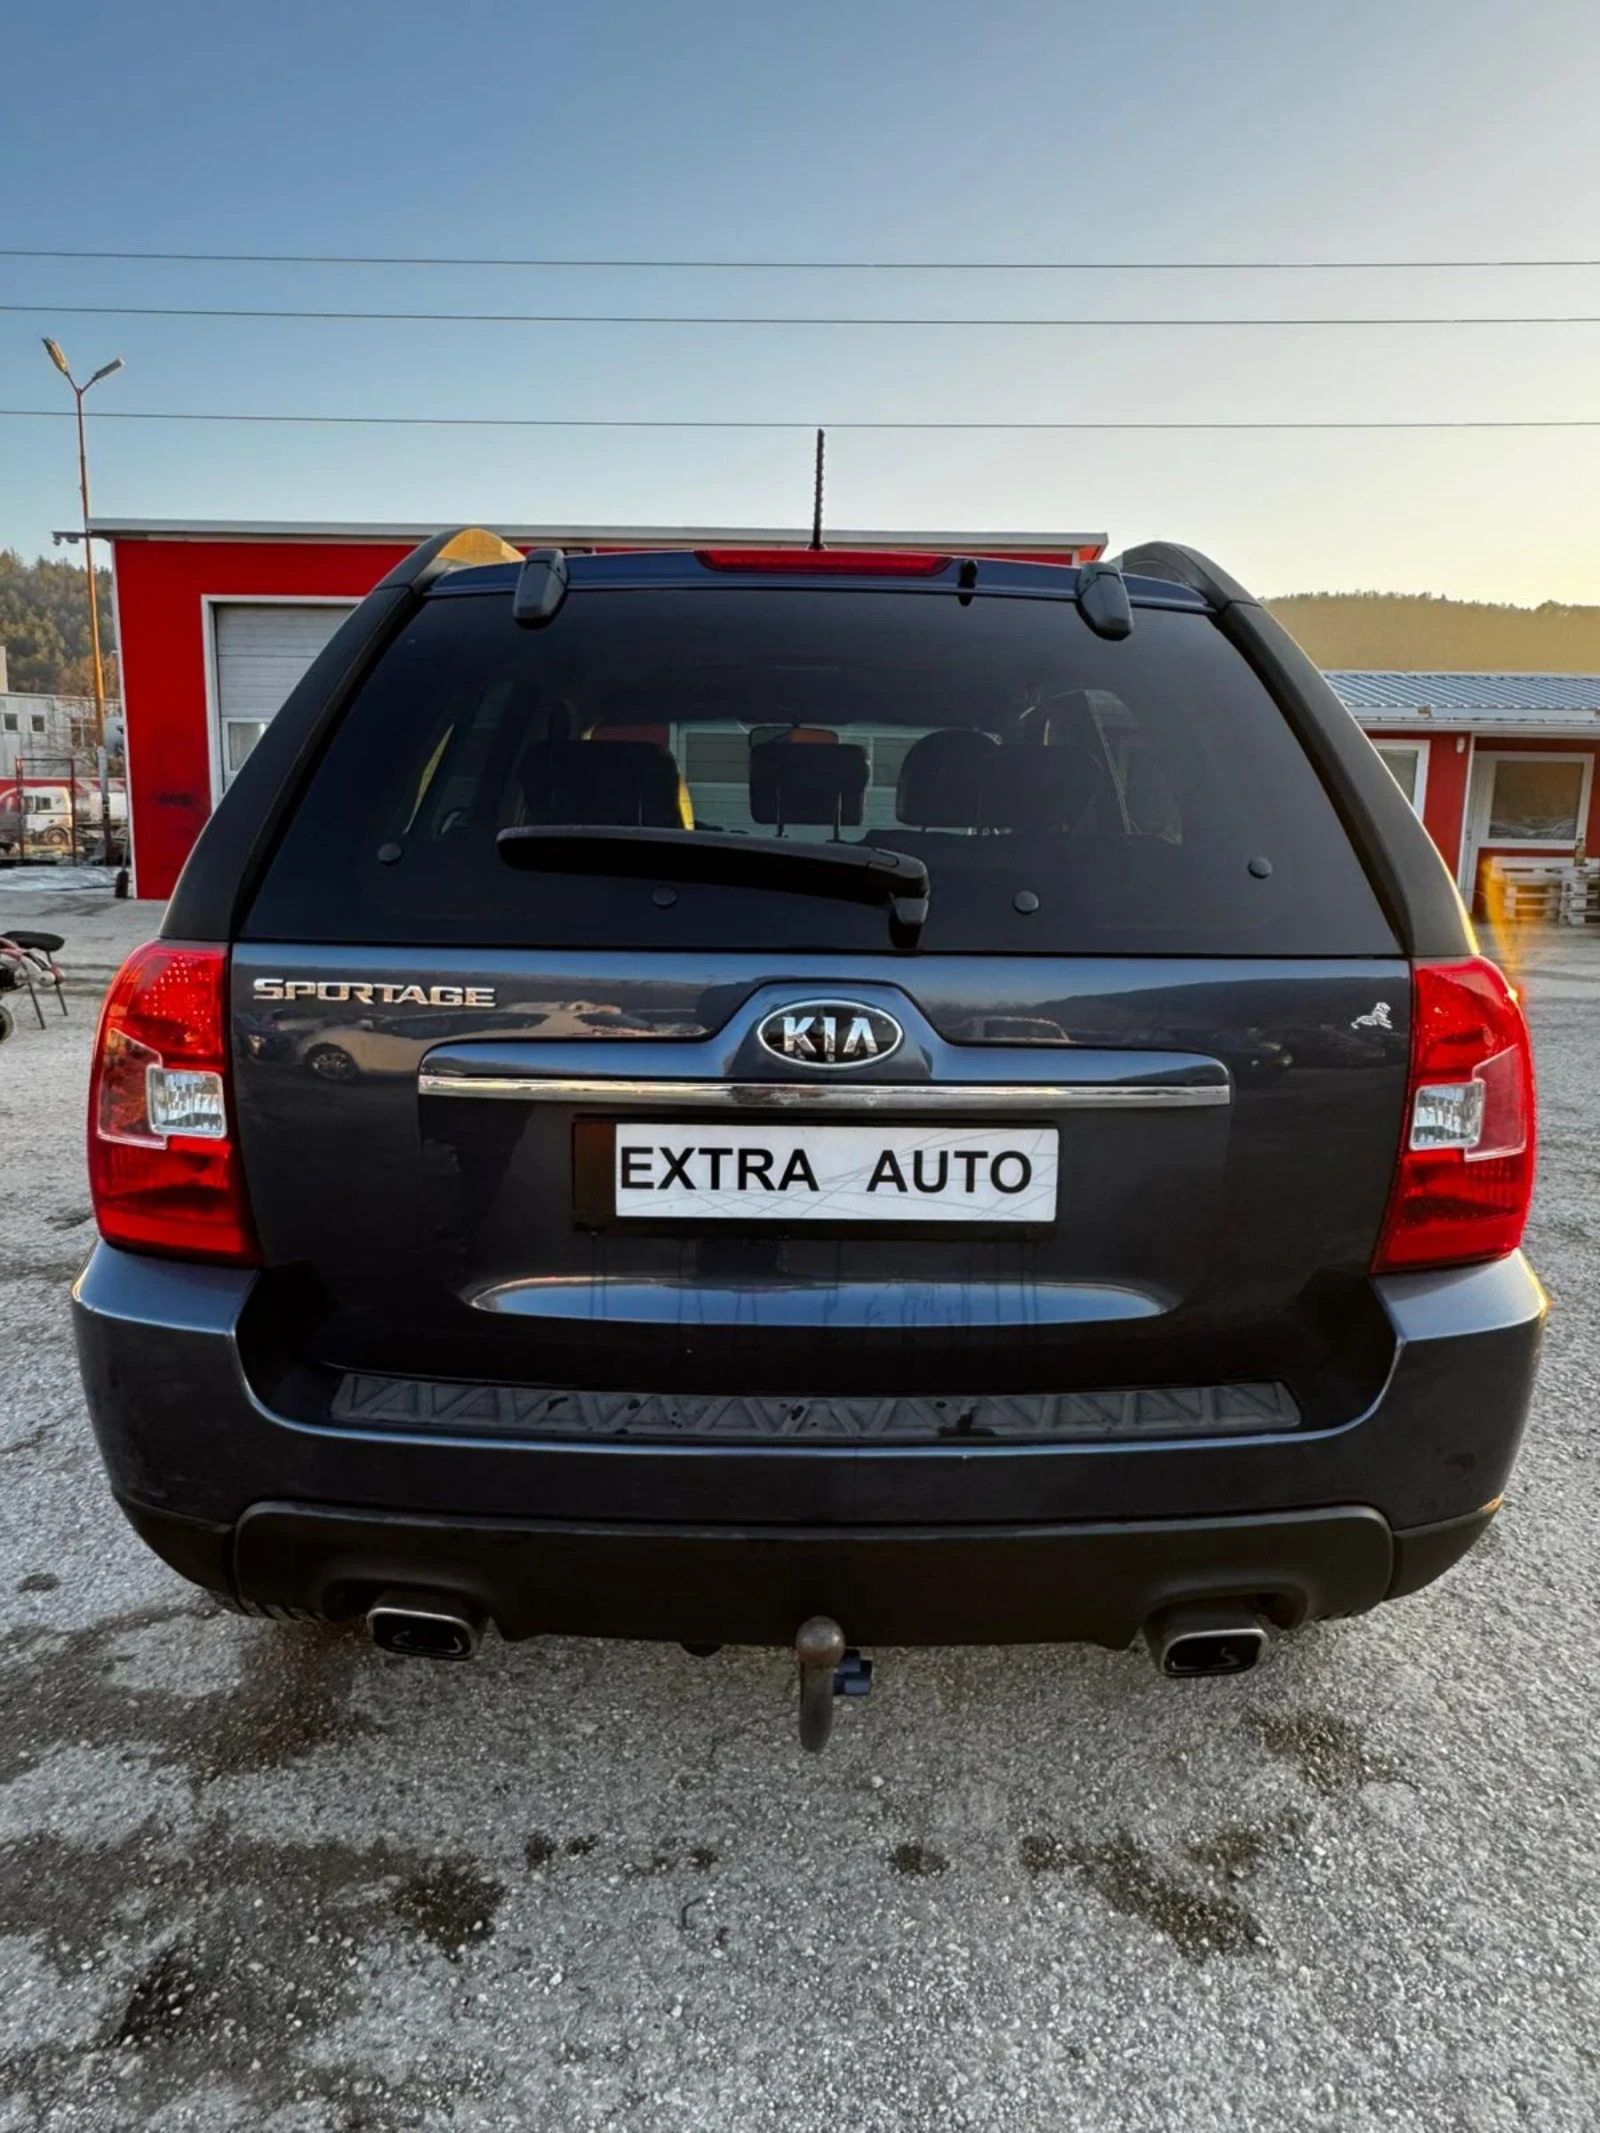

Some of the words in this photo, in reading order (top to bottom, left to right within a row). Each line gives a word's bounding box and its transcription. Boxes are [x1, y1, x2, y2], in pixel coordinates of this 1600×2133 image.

[253, 978, 496, 1007] SPORTAGE
[782, 1016, 879, 1054] KIA
[620, 1146, 820, 1192] EXTRA
[866, 1149, 1033, 1194] AUTO
